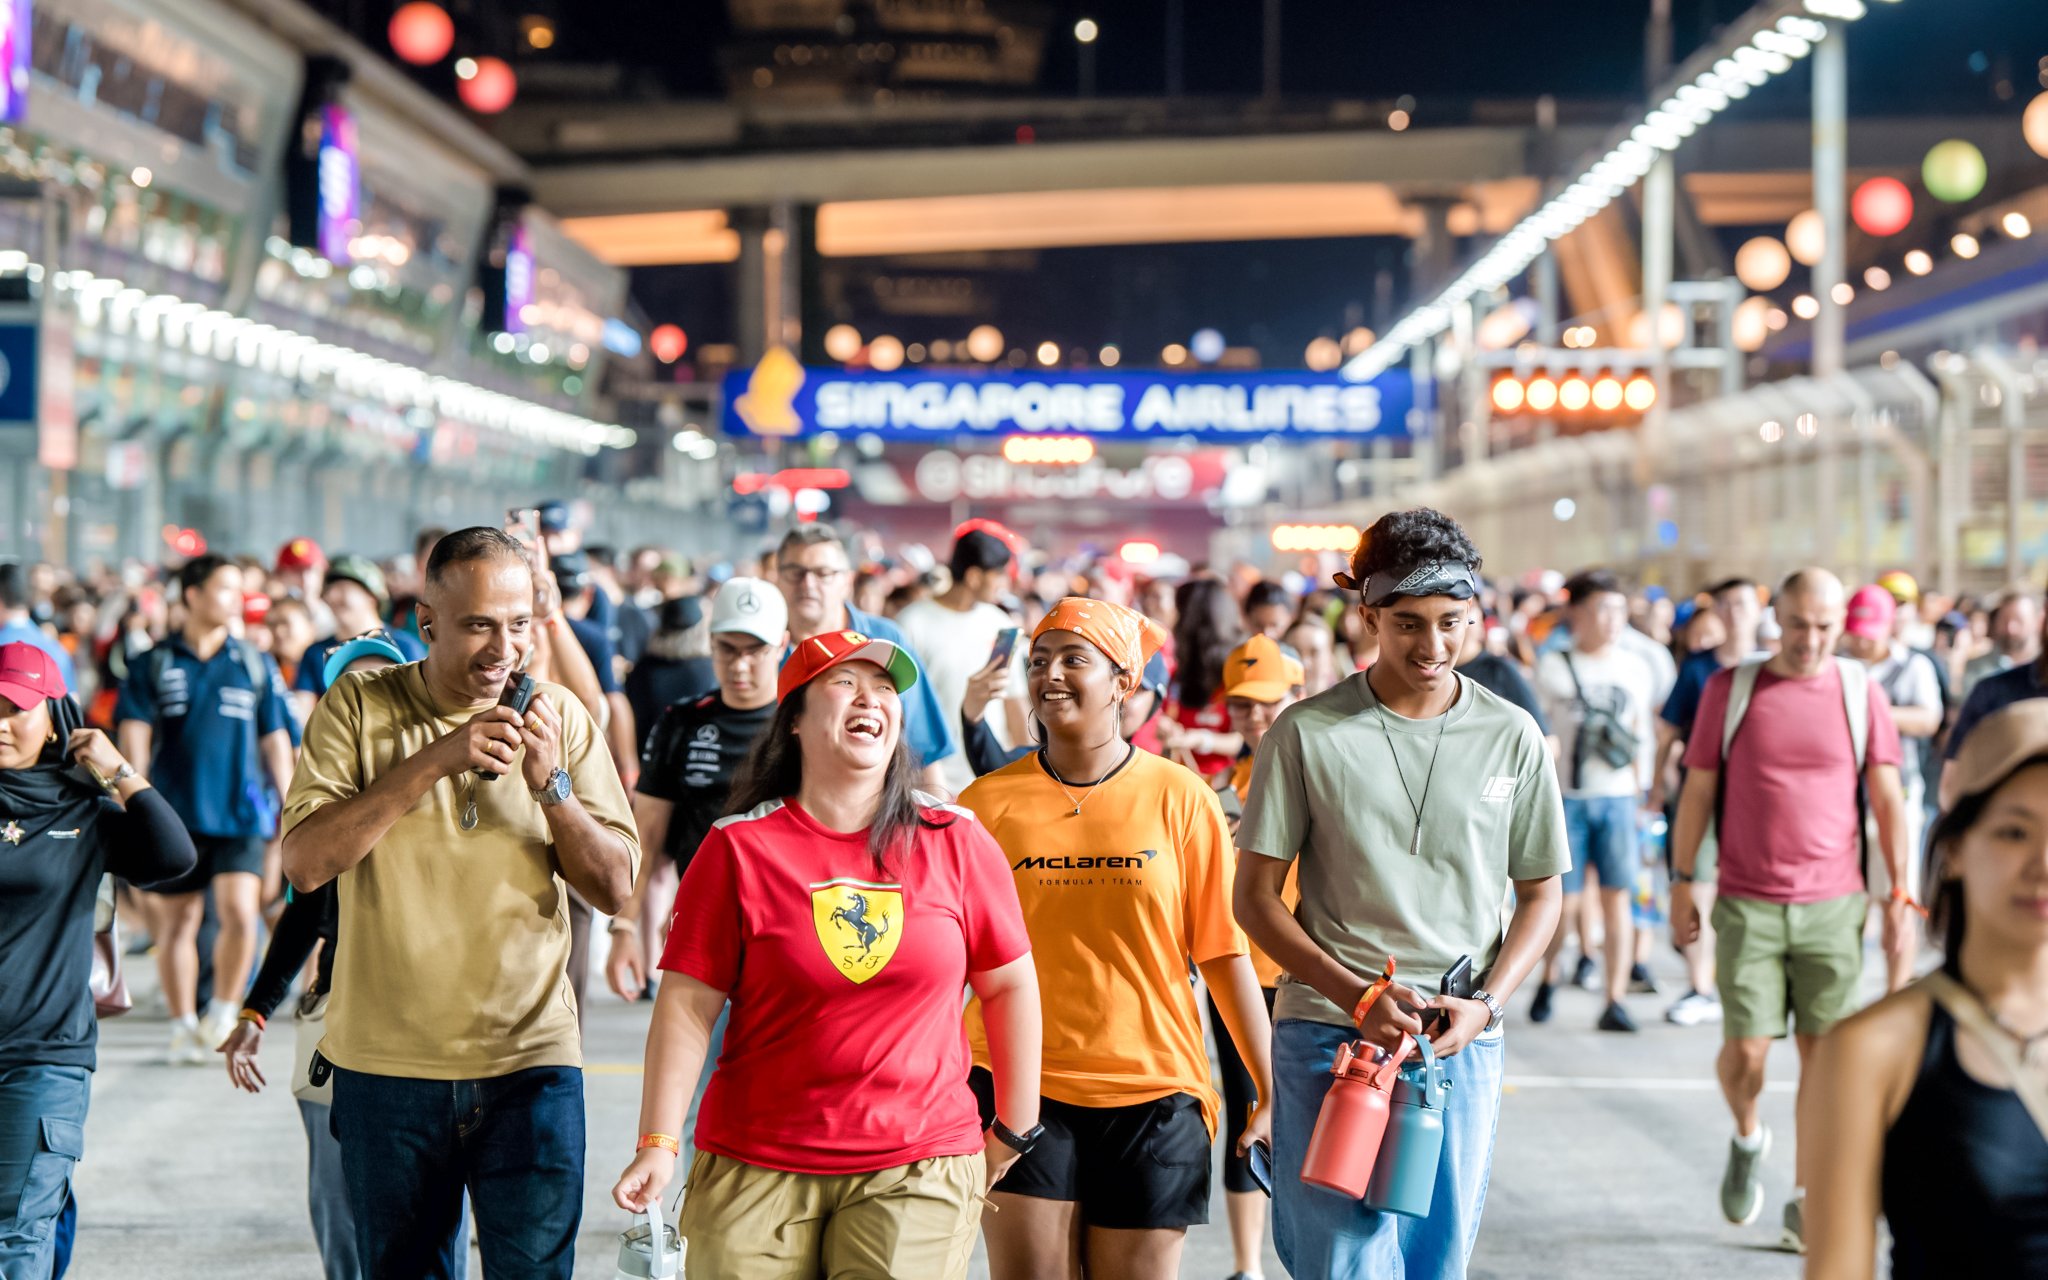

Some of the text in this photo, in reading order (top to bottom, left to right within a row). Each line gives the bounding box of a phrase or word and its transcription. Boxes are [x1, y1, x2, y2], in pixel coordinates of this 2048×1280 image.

[1013, 856, 1143, 871] McLaren
[1039, 878, 1142, 886] FORMULA 1 TEAM
[842, 955, 854, 970] S
